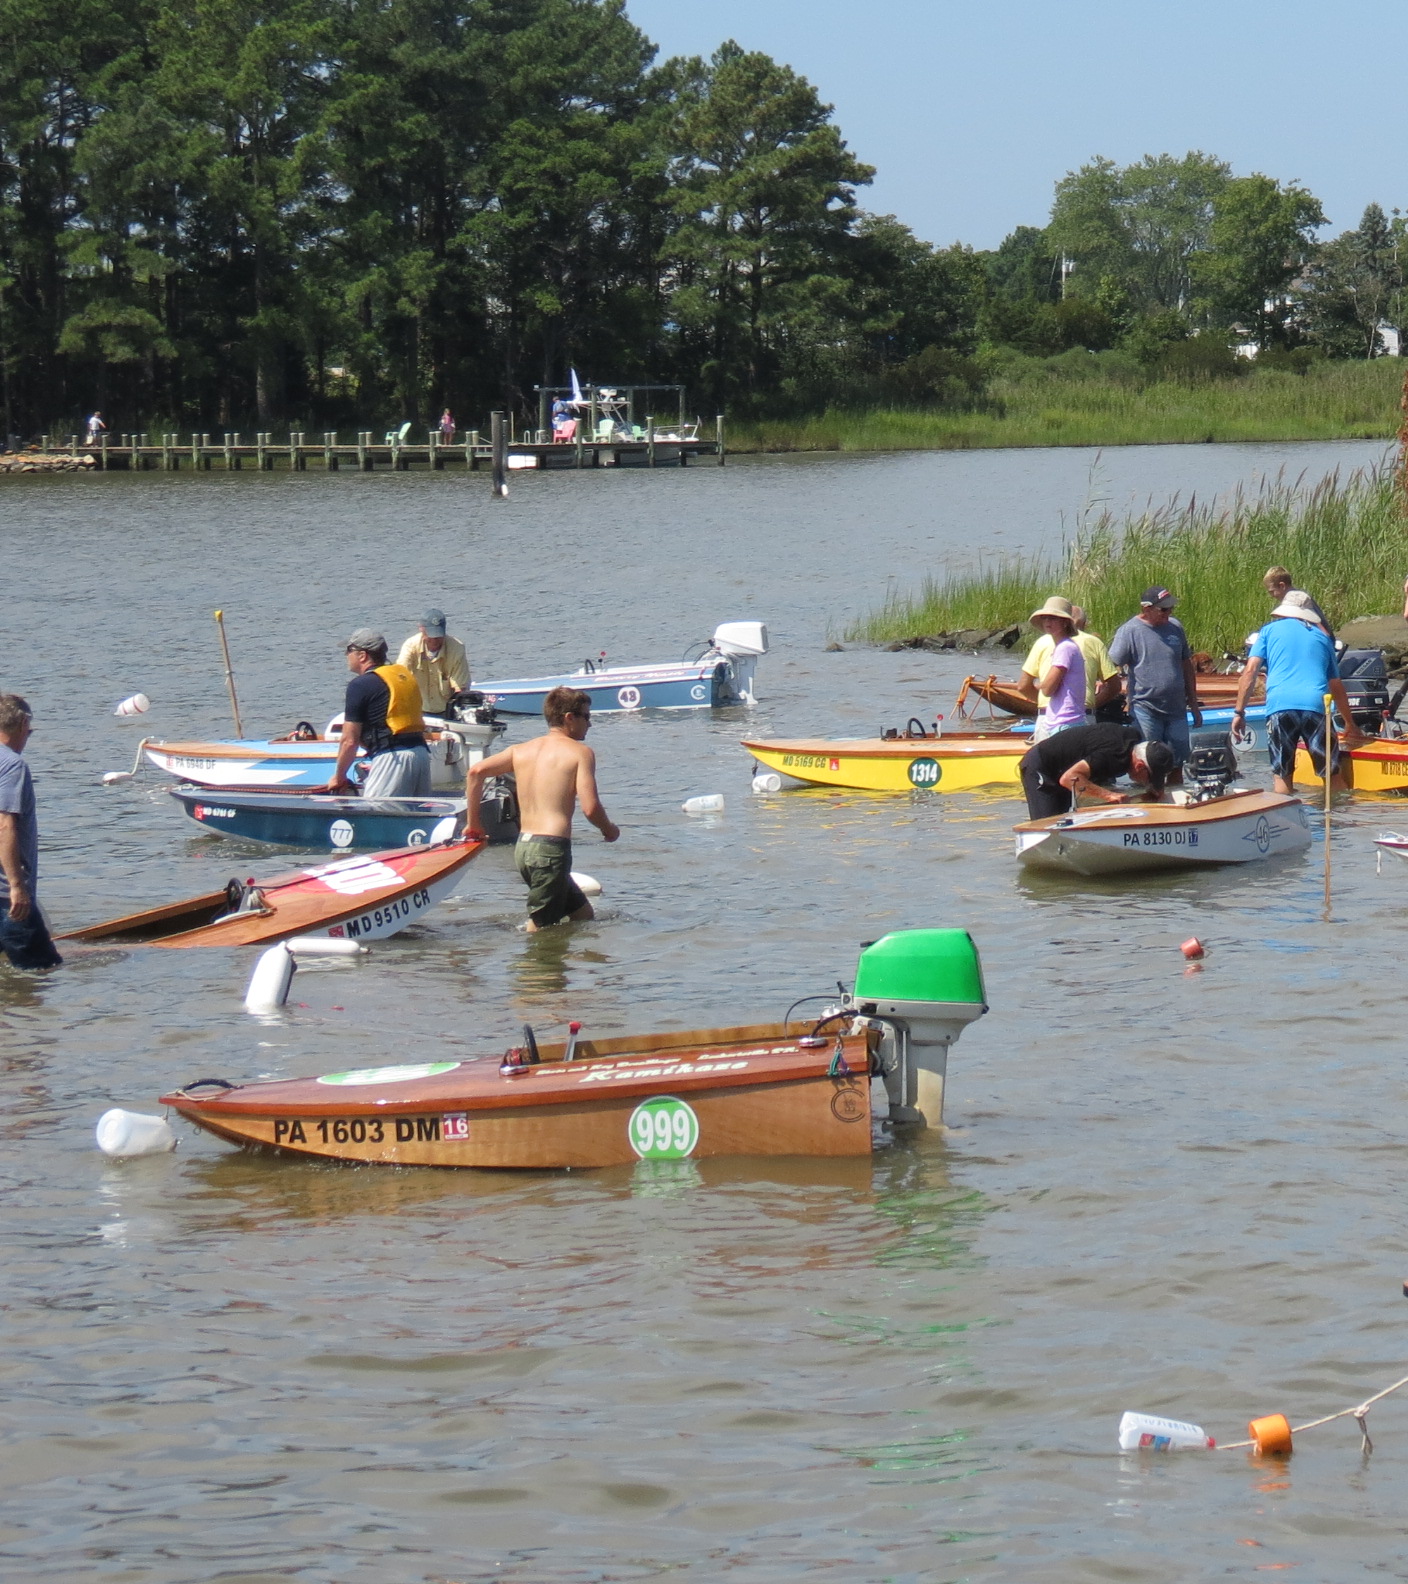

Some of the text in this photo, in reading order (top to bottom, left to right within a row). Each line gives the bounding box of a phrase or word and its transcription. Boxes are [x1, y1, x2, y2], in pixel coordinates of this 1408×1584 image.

[175, 757, 185, 767] PA
[206, 759, 216, 770] DF
[782, 756, 793, 766] MD
[794, 756, 813, 768] 5169
[911, 763, 938, 782] 1314
[331, 827, 351, 840] 777
[1123, 830, 1186, 847] PA 8130 DJ
[1258, 825, 1269, 844] 46
[346, 888, 431, 938] MD 9510 CR
[579, 1061, 749, 1083] Kamikaze
[274, 1117, 441, 1144] PA 1603 DM
[444, 1118, 468, 1134] 16
[636, 1109, 691, 1152] 999
